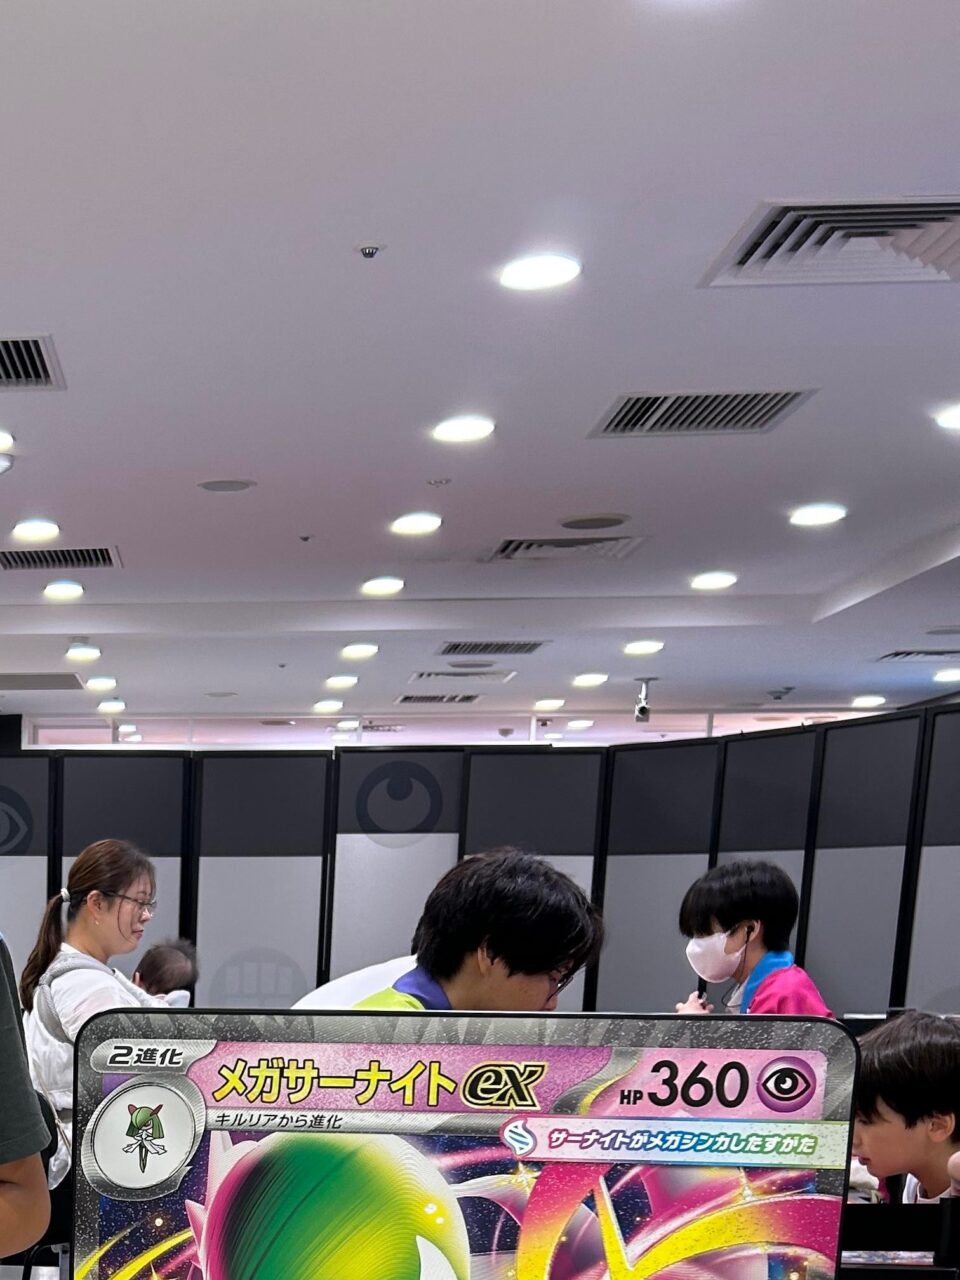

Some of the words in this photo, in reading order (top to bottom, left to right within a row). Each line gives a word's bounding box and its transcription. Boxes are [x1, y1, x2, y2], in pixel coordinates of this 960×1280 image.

[108, 1045, 183, 1067] 2進化
[212, 1057, 457, 1106] メガサーナイト
[619, 1090, 643, 1106] HP
[649, 1059, 749, 1108] 360
[215, 1112, 343, 1130] キルリアから進化
[548, 1129, 818, 1155] サーナイトがメガシンカしたすがた
